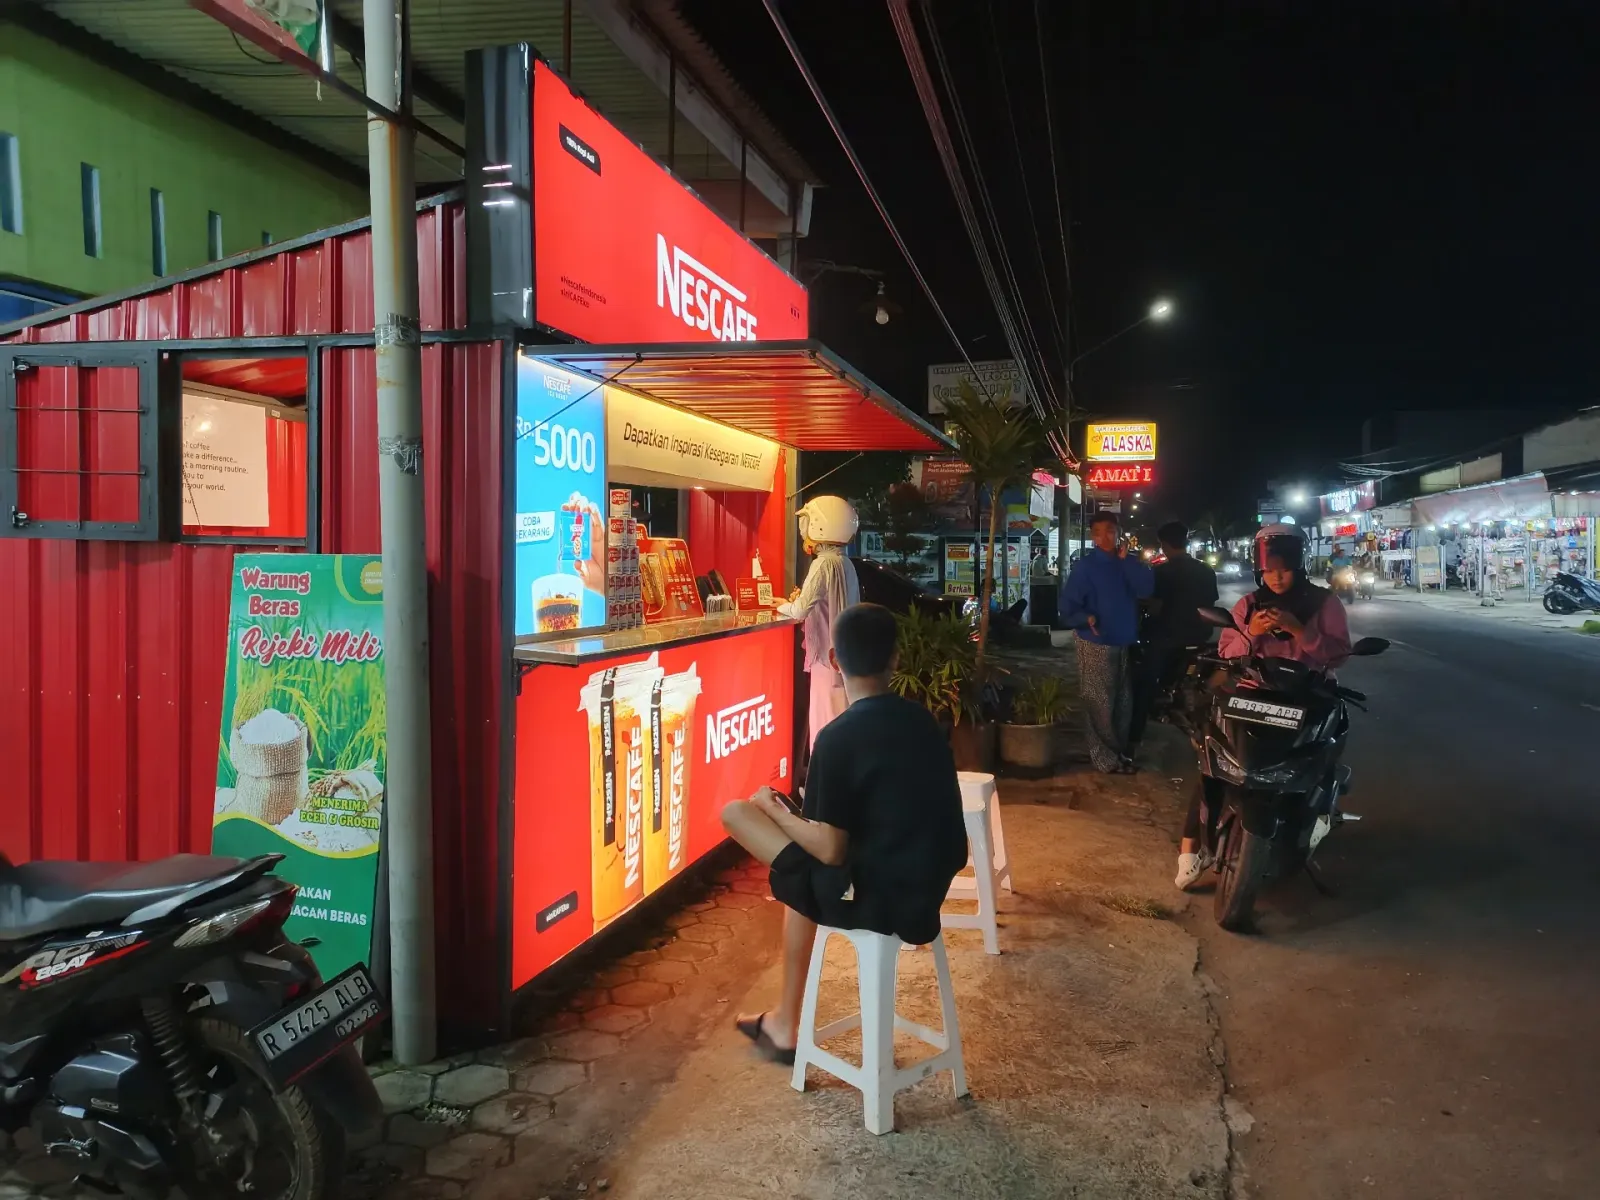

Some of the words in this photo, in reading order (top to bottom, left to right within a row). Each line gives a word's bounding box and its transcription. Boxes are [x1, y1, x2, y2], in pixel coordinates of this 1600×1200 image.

[189, 443, 210, 451] coffee
[533, 419, 596, 474] 5000
[623, 422, 669, 450] Dapatkan
[670, 434, 705, 458] Inspirasi
[704, 442, 739, 467] Kesegaran
[1102, 434, 1153, 452] ALASKA
[195, 463, 223, 474] morning
[196, 472, 204, 480] to
[523, 516, 541, 527] COBA
[241, 567, 311, 595] Warung
[947, 583, 972, 594] Berkah
[249, 595, 300, 617] Beras
[240, 626, 317, 666] Rejeki
[319, 630, 380, 665] Mili
[311, 796, 369, 812] MENERIMA
[300, 812, 327, 824] ECER
[329, 813, 338, 825] &
[339, 816, 379, 830] GROSIR
[330, 909, 367, 926] BERAS
[262, 1032, 282, 1057] R
[281, 999, 331, 1042] 5425
[334, 975, 369, 1010] ALB
